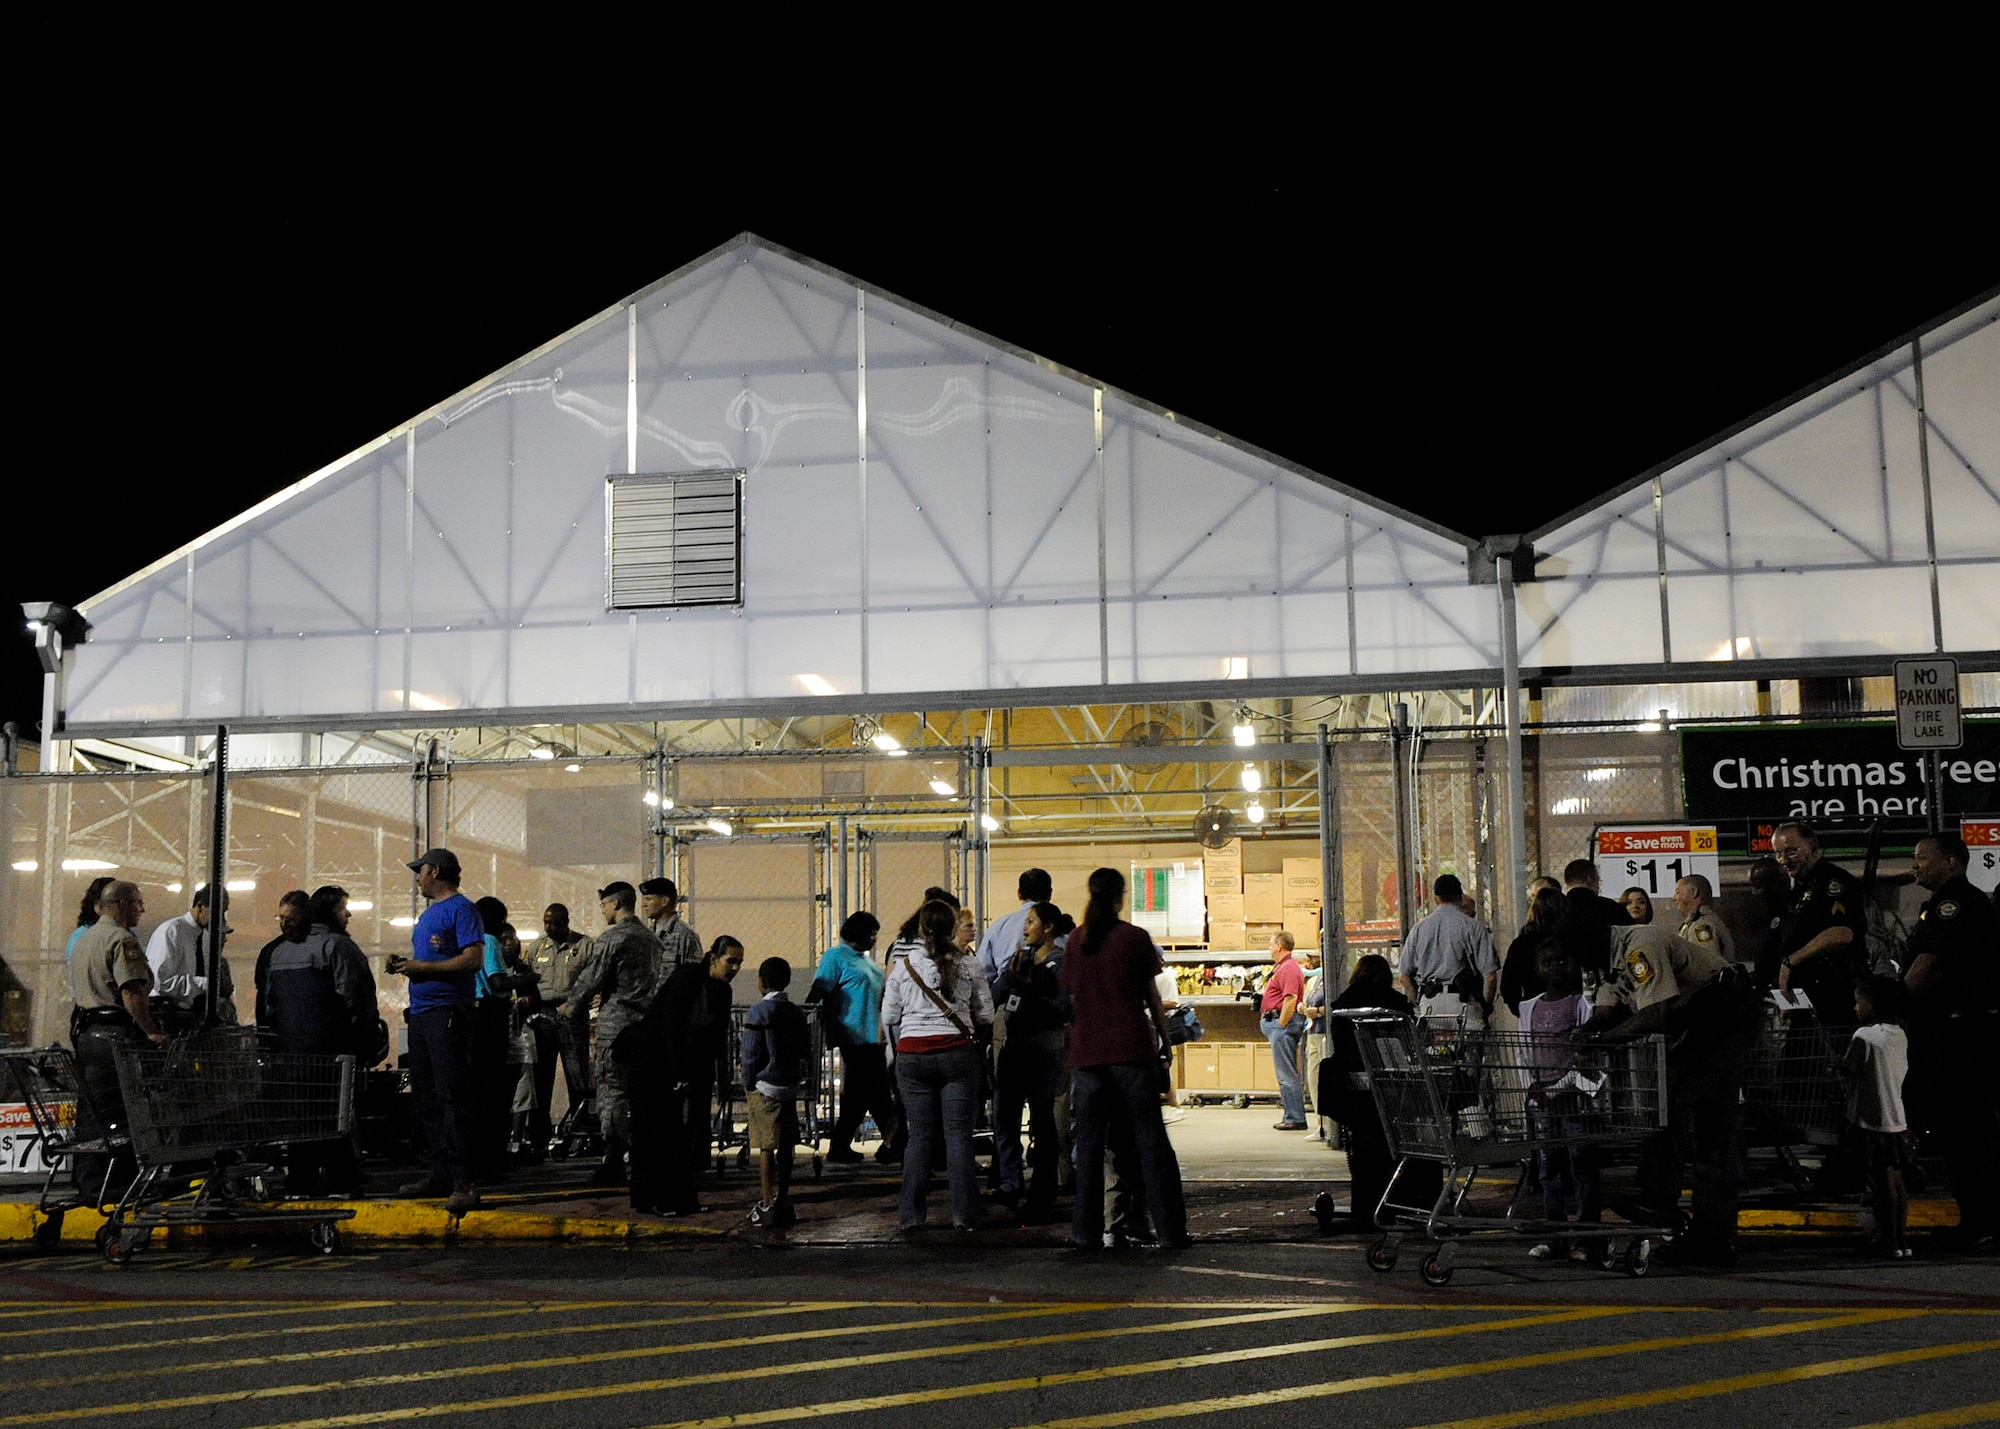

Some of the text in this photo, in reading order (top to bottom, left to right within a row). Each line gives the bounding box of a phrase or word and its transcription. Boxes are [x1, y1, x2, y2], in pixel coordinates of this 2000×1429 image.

[1914, 668, 1937, 685] NO
[1900, 688, 1955, 705] PARKING
[1915, 710, 1942, 722] FIRE
[1914, 726, 1944, 737] LANE
[1712, 757, 1907, 790] Christmas
[1788, 799, 1846, 822] are
[1757, 824, 1773, 837] NO
[1624, 837, 1660, 850] Save
